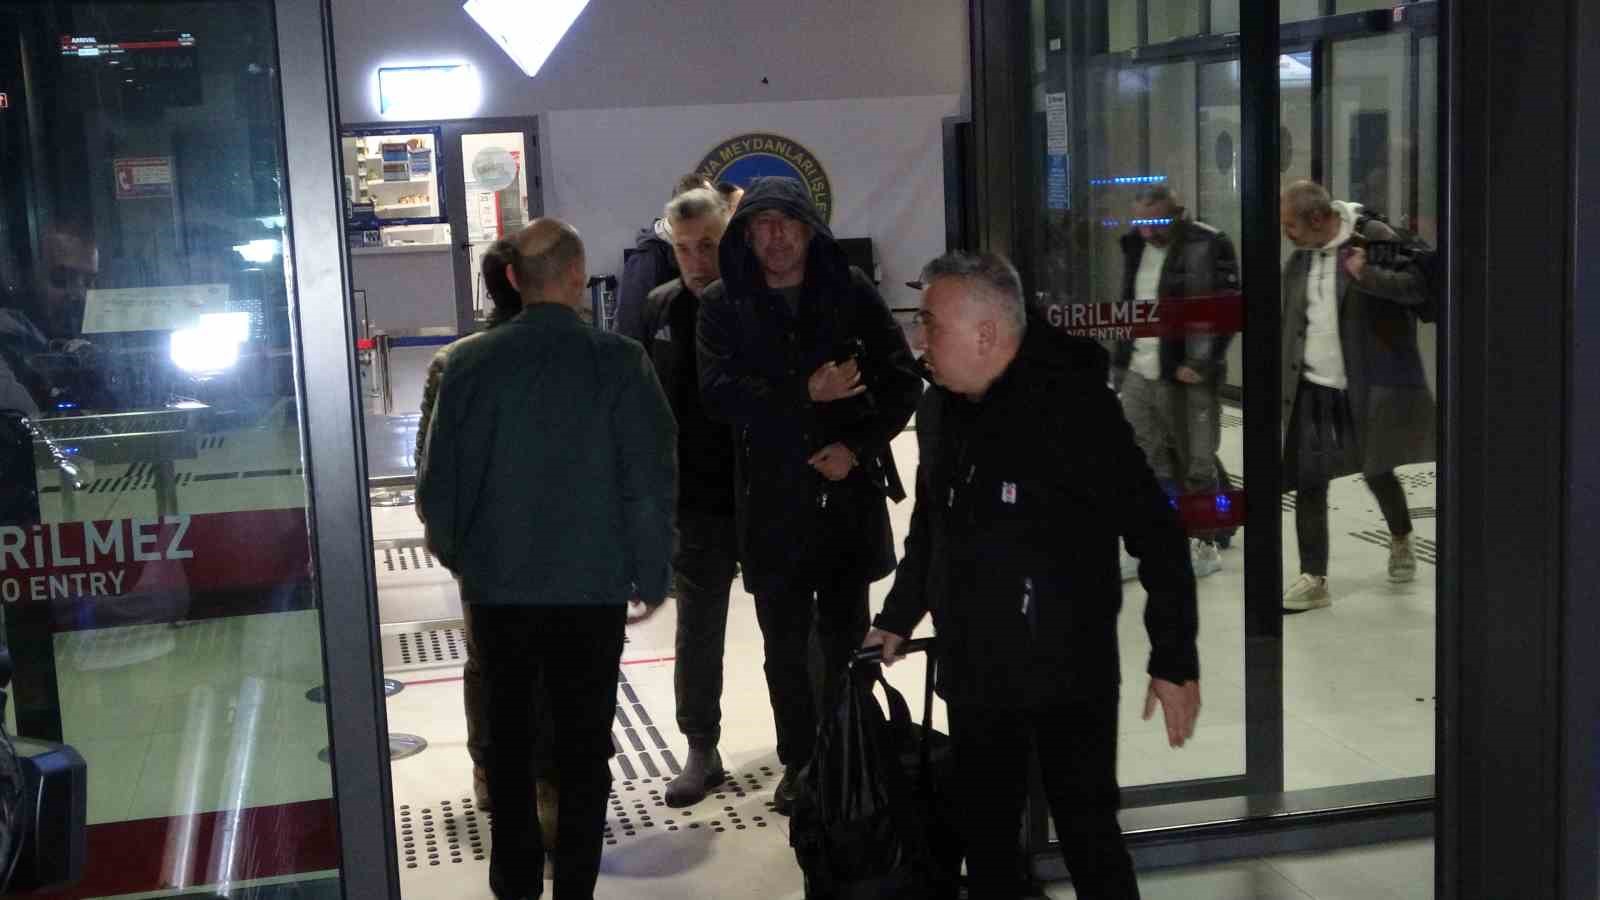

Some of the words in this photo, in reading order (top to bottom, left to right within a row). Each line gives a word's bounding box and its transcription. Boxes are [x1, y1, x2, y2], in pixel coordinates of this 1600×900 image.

[703, 158, 720, 181] VA
[1088, 326, 1133, 341] ENTRY
[31, 570, 125, 600] ENTRY
